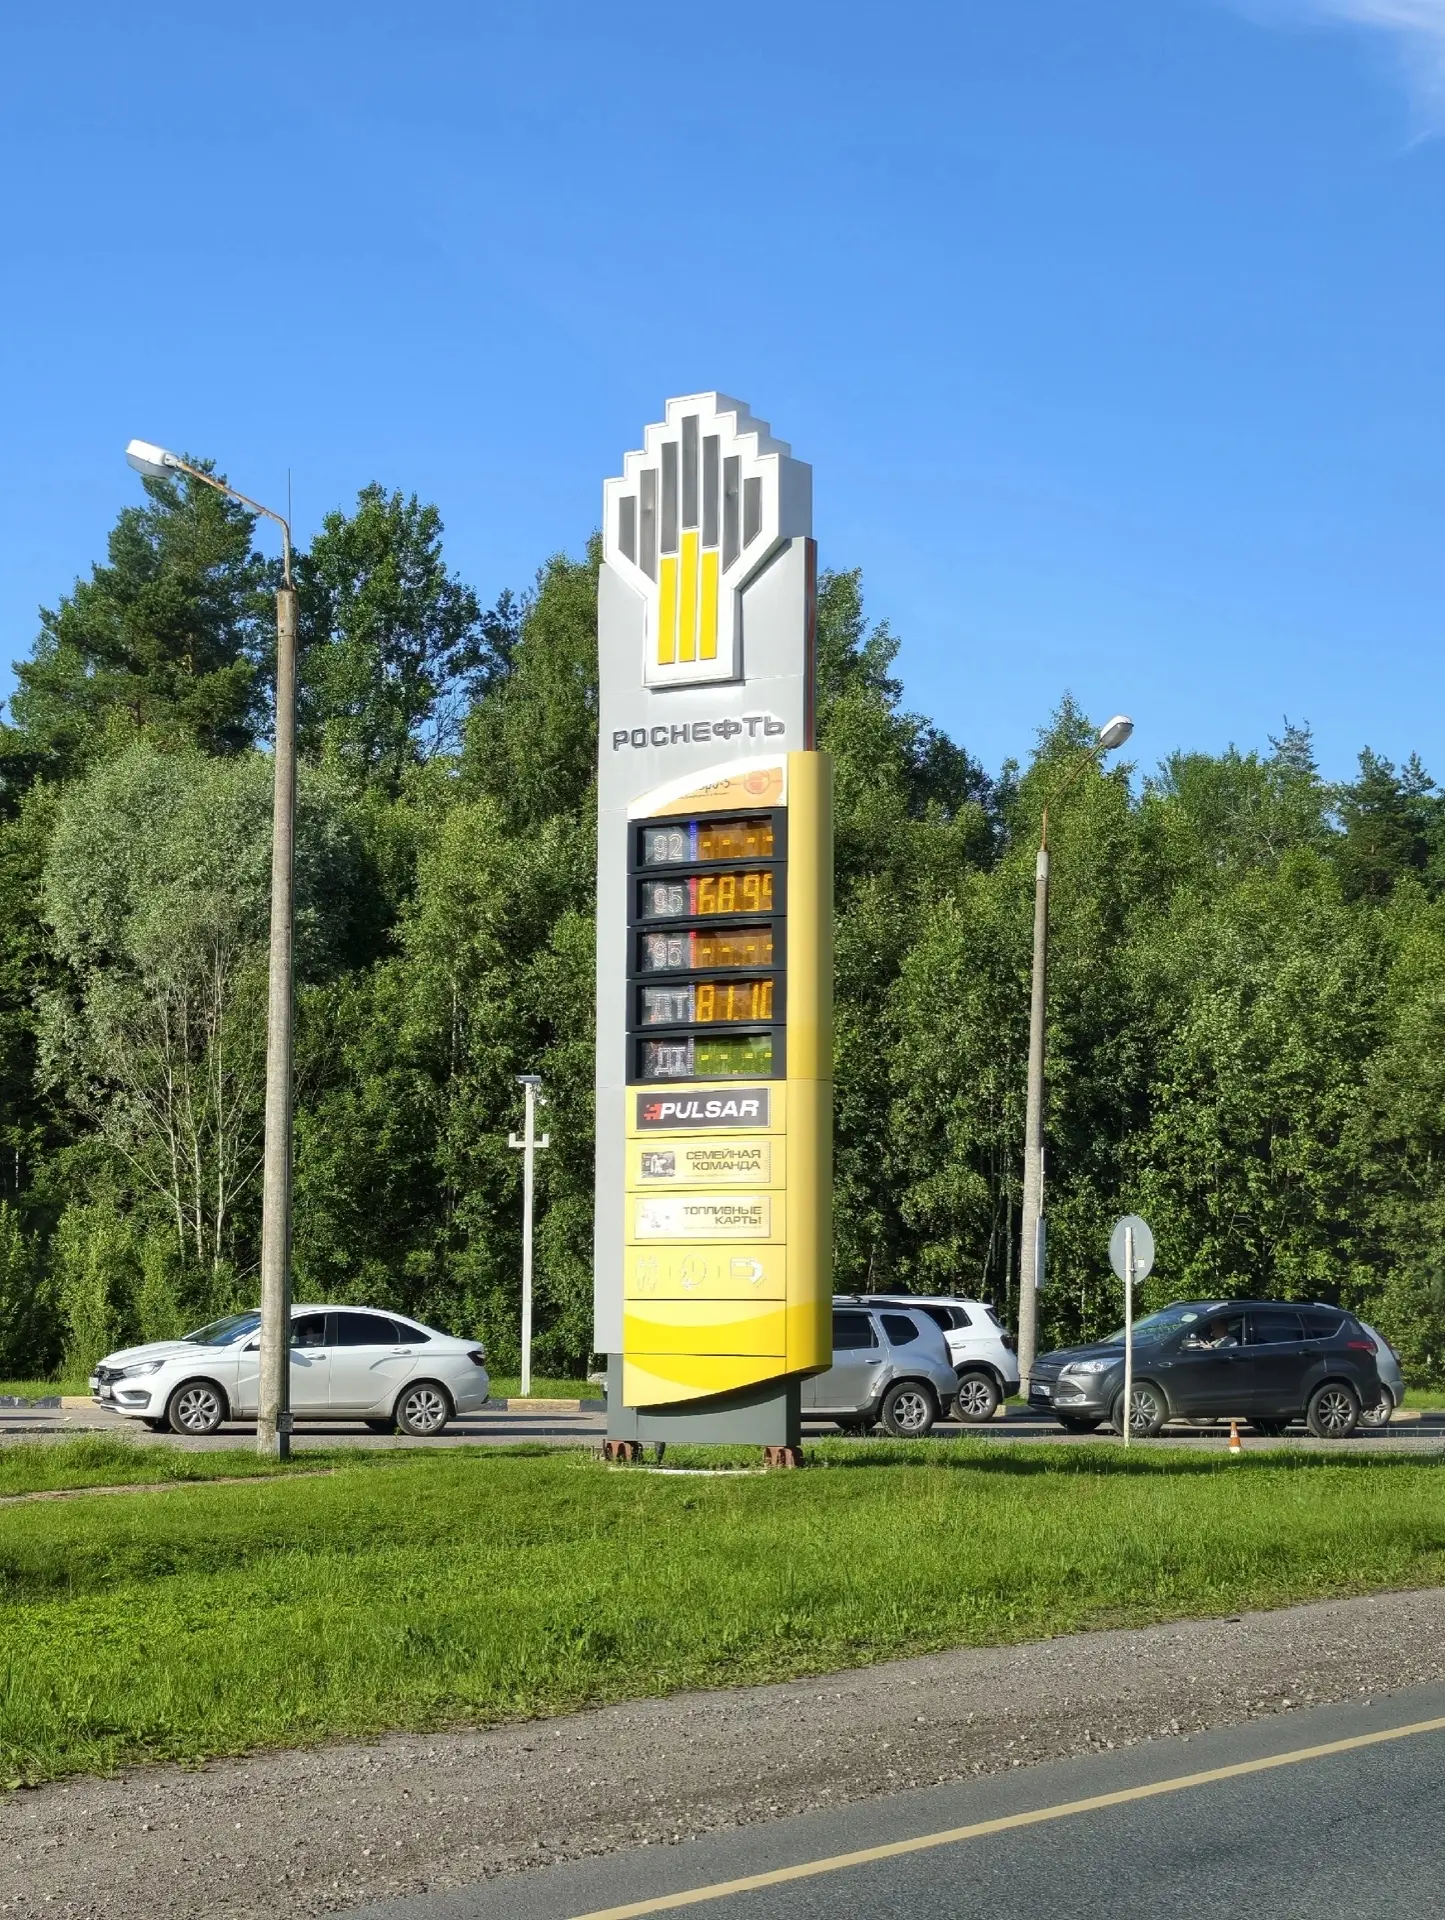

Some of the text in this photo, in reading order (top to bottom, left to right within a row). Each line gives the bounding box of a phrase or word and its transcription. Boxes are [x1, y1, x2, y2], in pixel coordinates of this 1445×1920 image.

[612, 715, 785, 751] РОСНЕФТЬ
[653, 832, 683, 861] 92
[653, 886, 683, 914] 95
[654, 940, 681, 967] 95
[659, 1099, 760, 1120] PULSAR
[686, 1148, 761, 1160] СЕМЕЙНАЯ
[692, 1161, 761, 1171] КОМАНДА
[683, 1206, 762, 1215] ТОПЛИВНЫЕ
[715, 1216, 762, 1225] КАРТЫ
